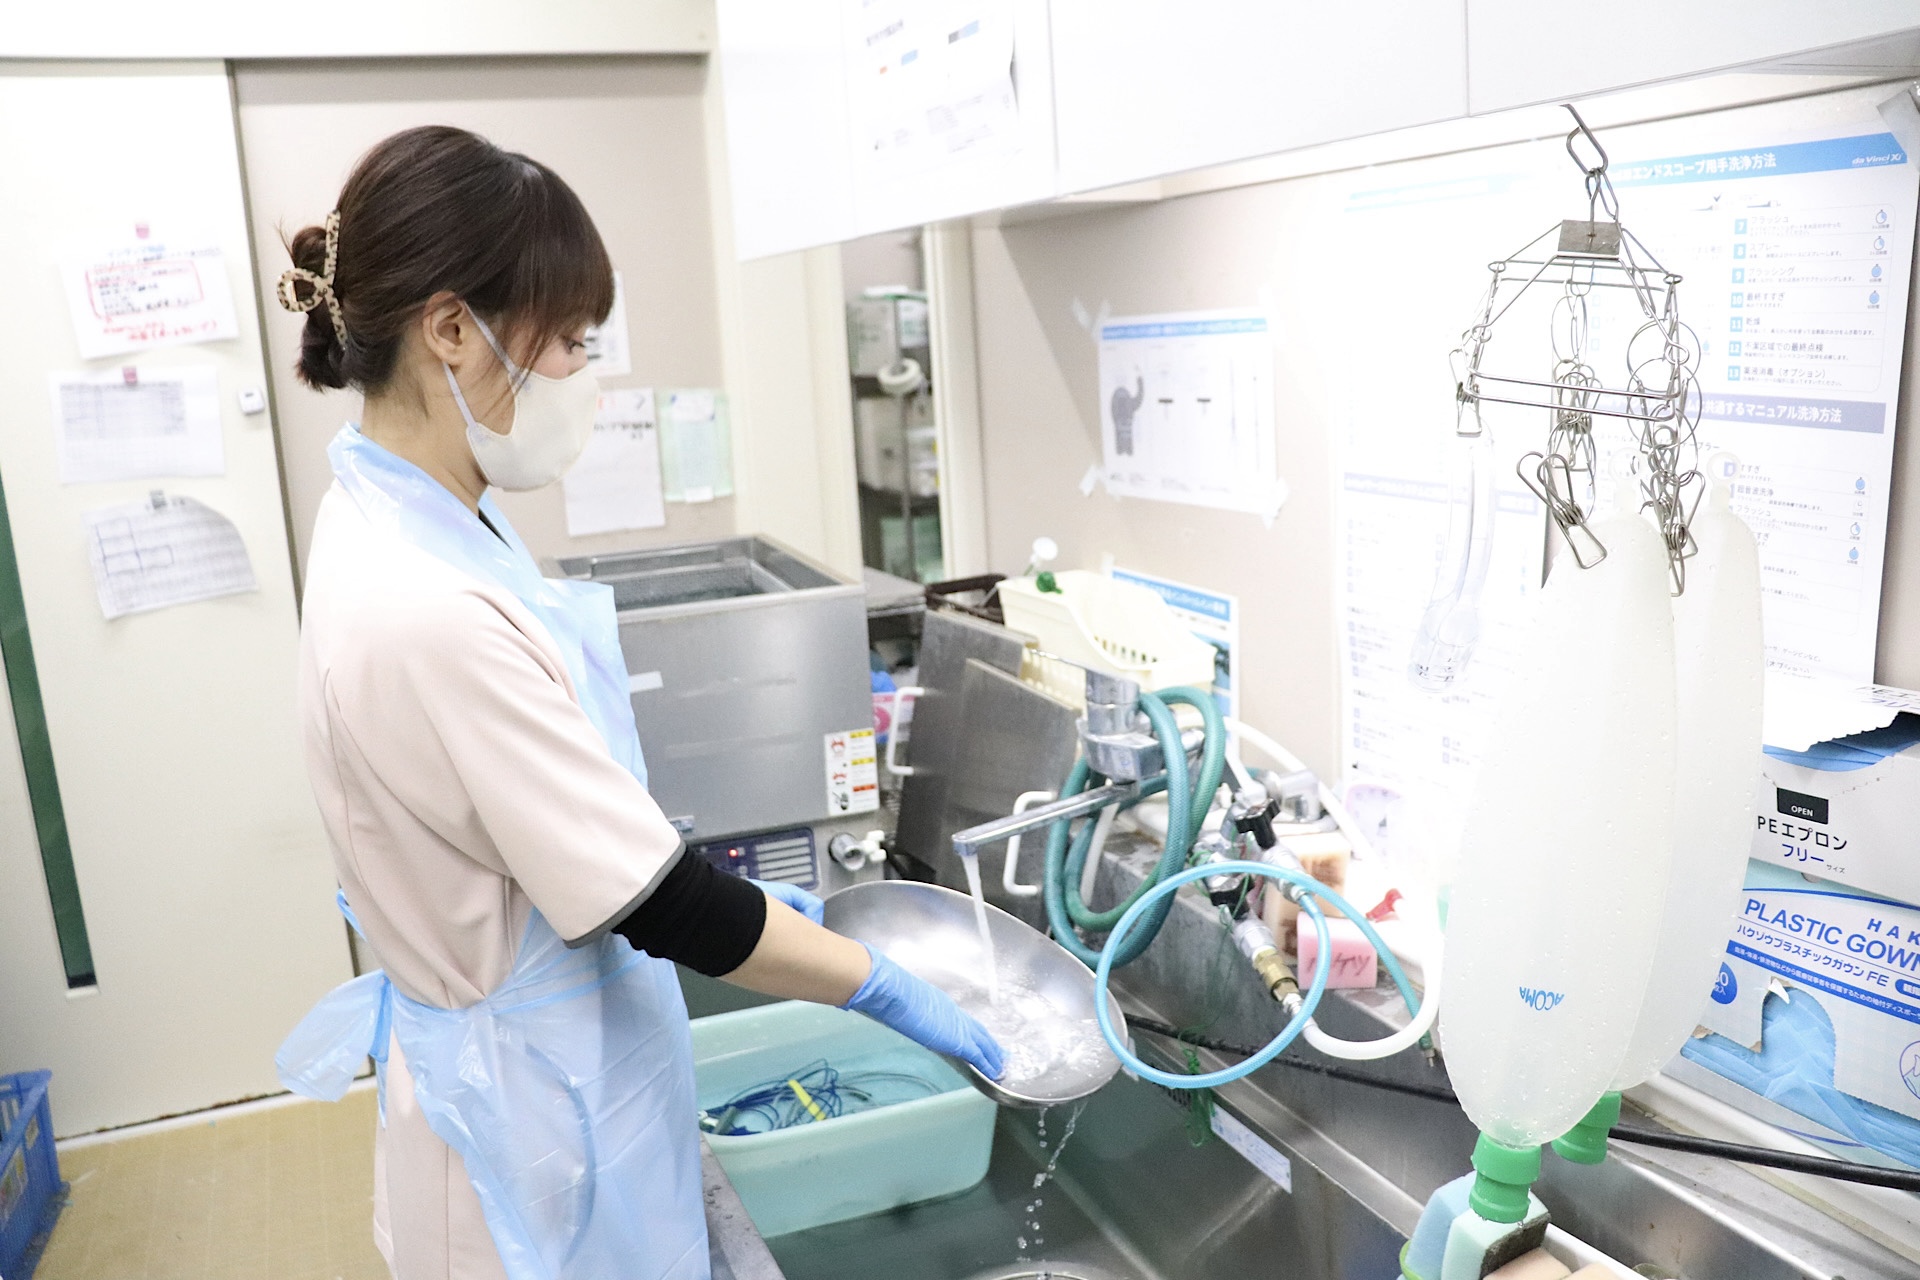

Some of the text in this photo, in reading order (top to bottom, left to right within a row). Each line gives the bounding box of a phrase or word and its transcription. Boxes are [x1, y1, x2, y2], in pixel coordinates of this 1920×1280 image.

[1732, 295, 1743, 304] 10
[1731, 320, 1742, 329] 11
[1730, 344, 1741, 354] 12
[1729, 369, 1739, 379] 13
[1790, 804, 1814, 817] OPEN
[1757, 815, 1848, 851] PEエプロン
[1781, 843, 1825, 862] フリー
[1744, 898, 1843, 945] PLASTIC
[1866, 970, 1890, 987] FE
[1519, 985, 1565, 1011] ACOMA
